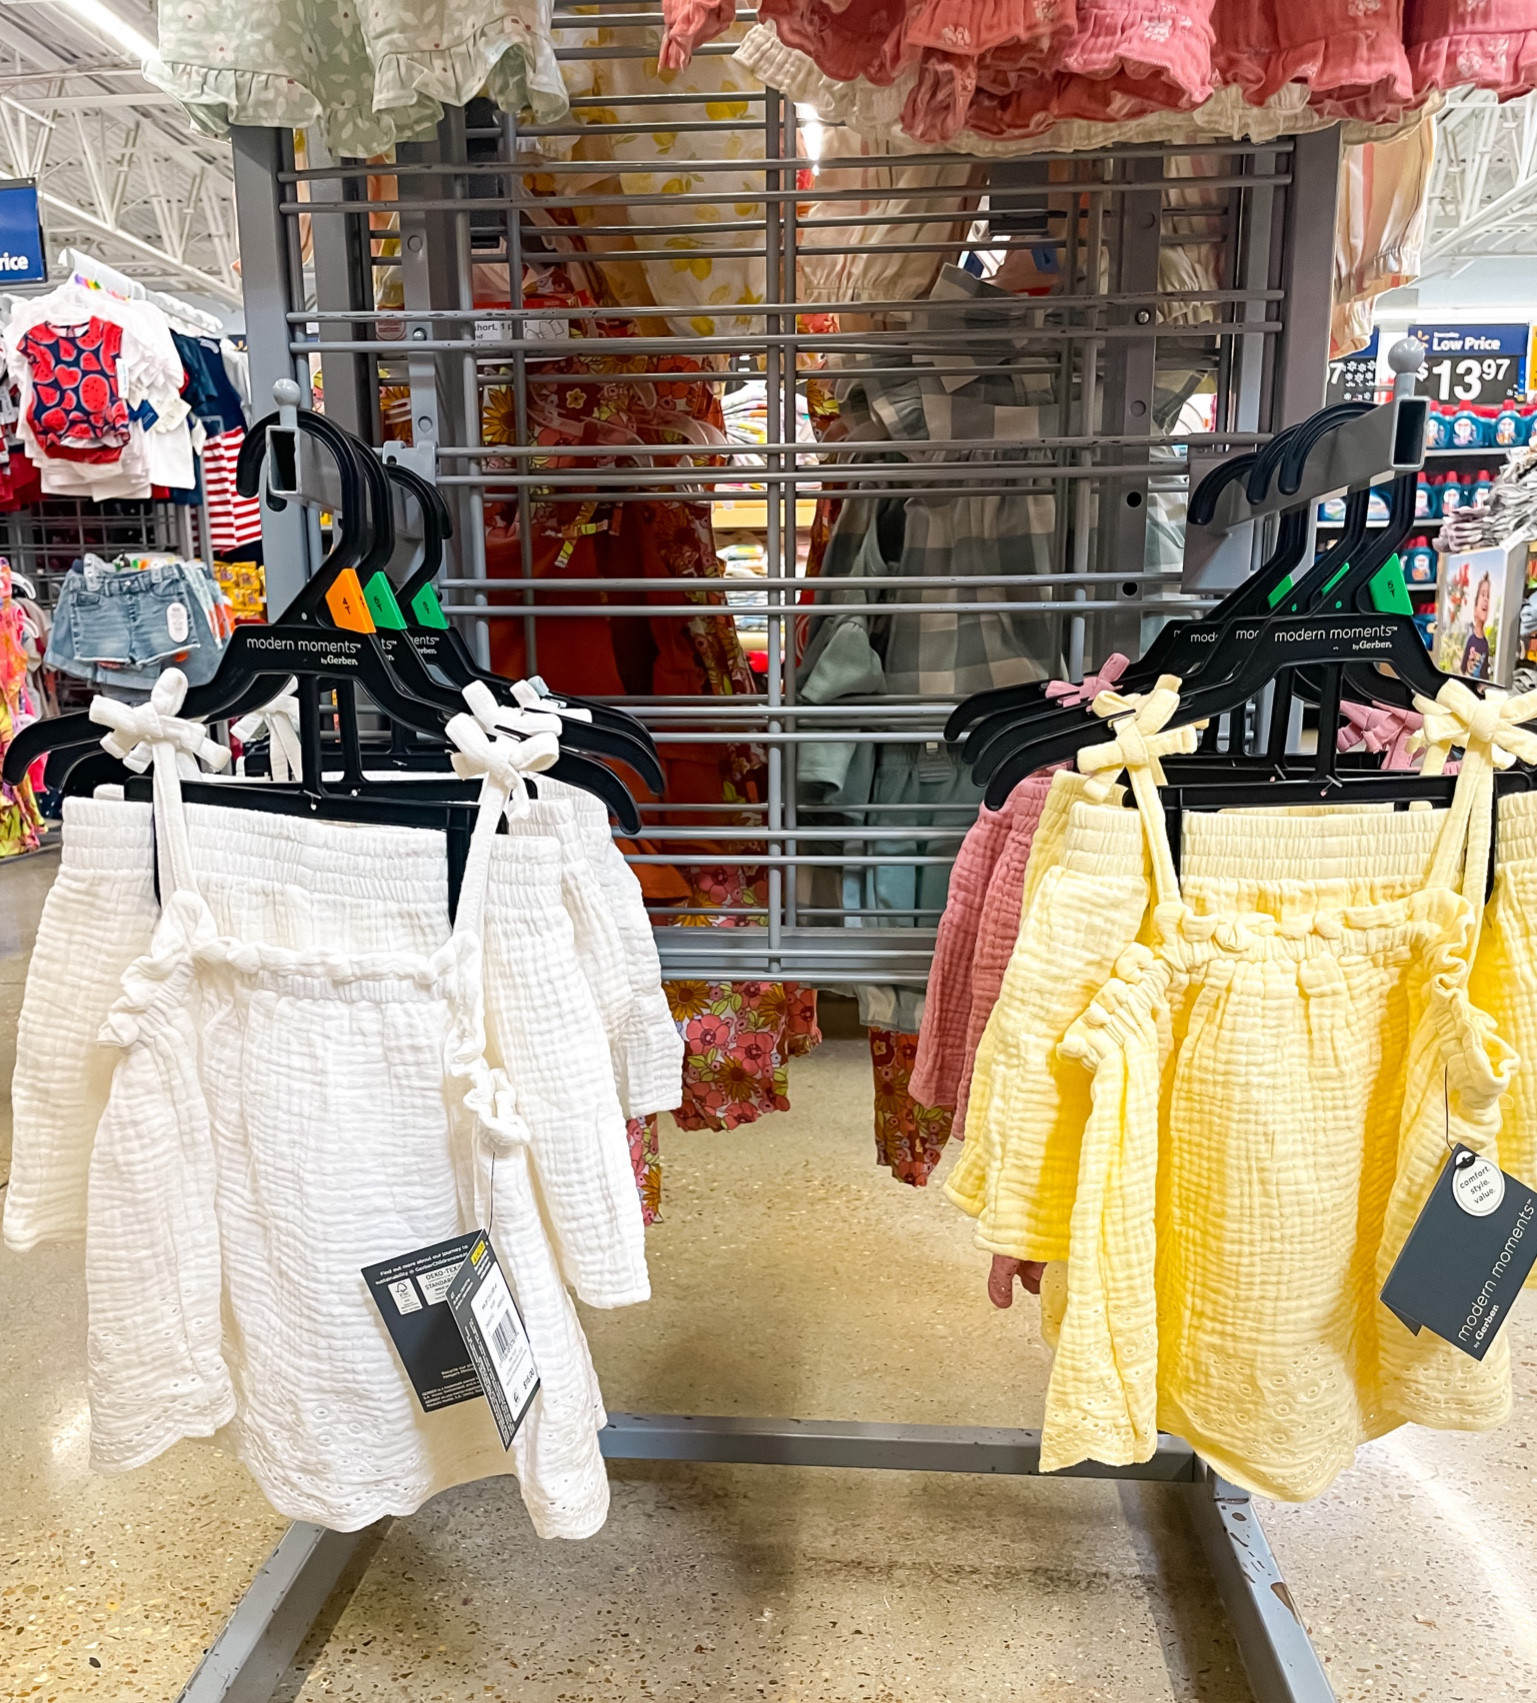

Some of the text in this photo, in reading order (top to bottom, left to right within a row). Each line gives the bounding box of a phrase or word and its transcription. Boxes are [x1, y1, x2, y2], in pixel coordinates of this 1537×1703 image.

[0, 251, 29, 271] rice
[1432, 336, 1501, 351] Low Price
[1274, 628, 1326, 642] modern
[246, 636, 294, 651] modern
[1460, 1166, 1491, 1189] comfort.
[442, 1246, 461, 1257] journey
[1458, 1280, 1497, 1342] modern
